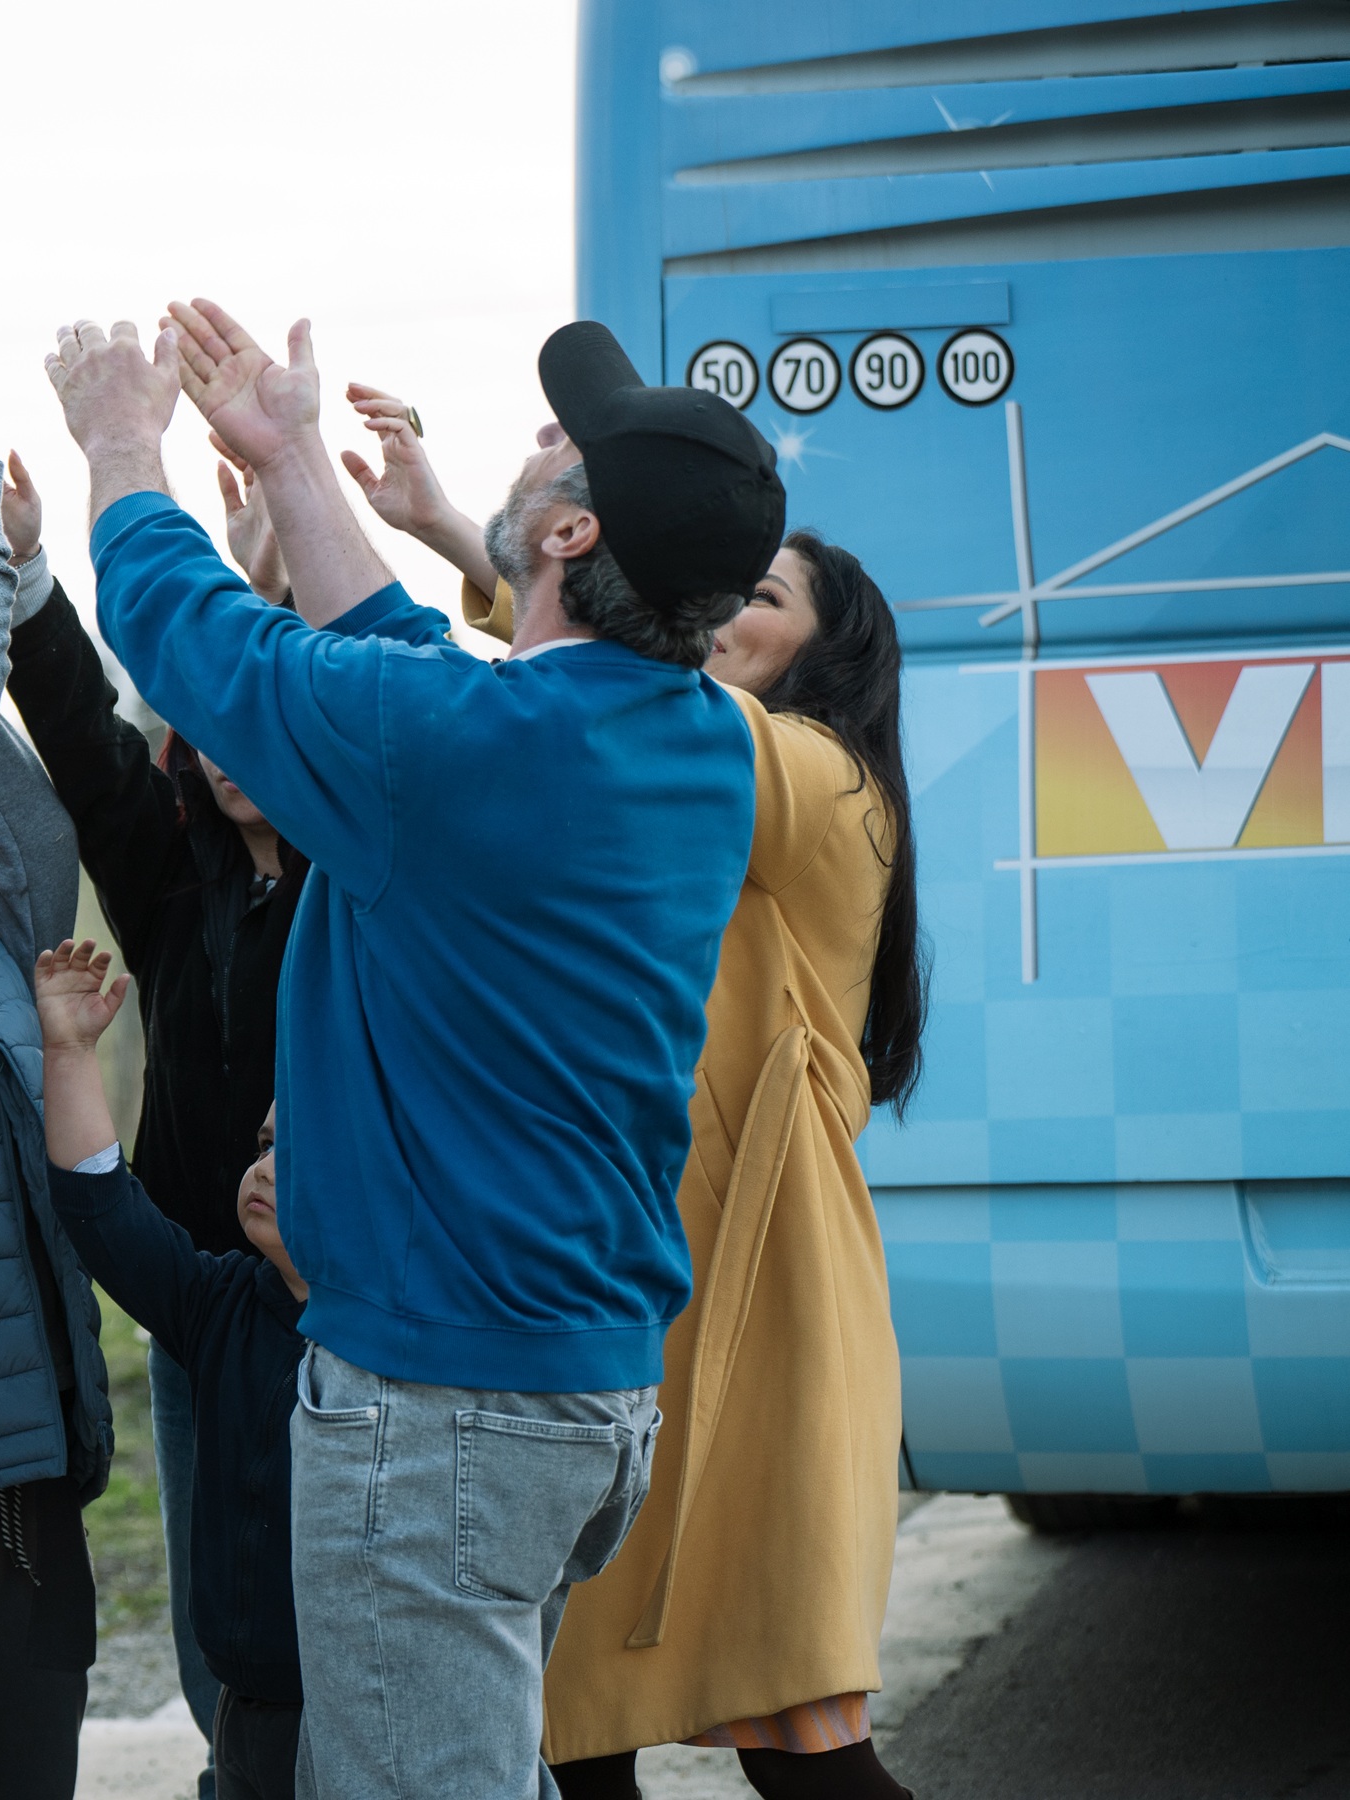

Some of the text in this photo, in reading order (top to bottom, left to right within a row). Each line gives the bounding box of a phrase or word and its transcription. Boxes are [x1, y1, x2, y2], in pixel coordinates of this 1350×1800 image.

[702, 350, 1001, 397] 50 70 90 100
